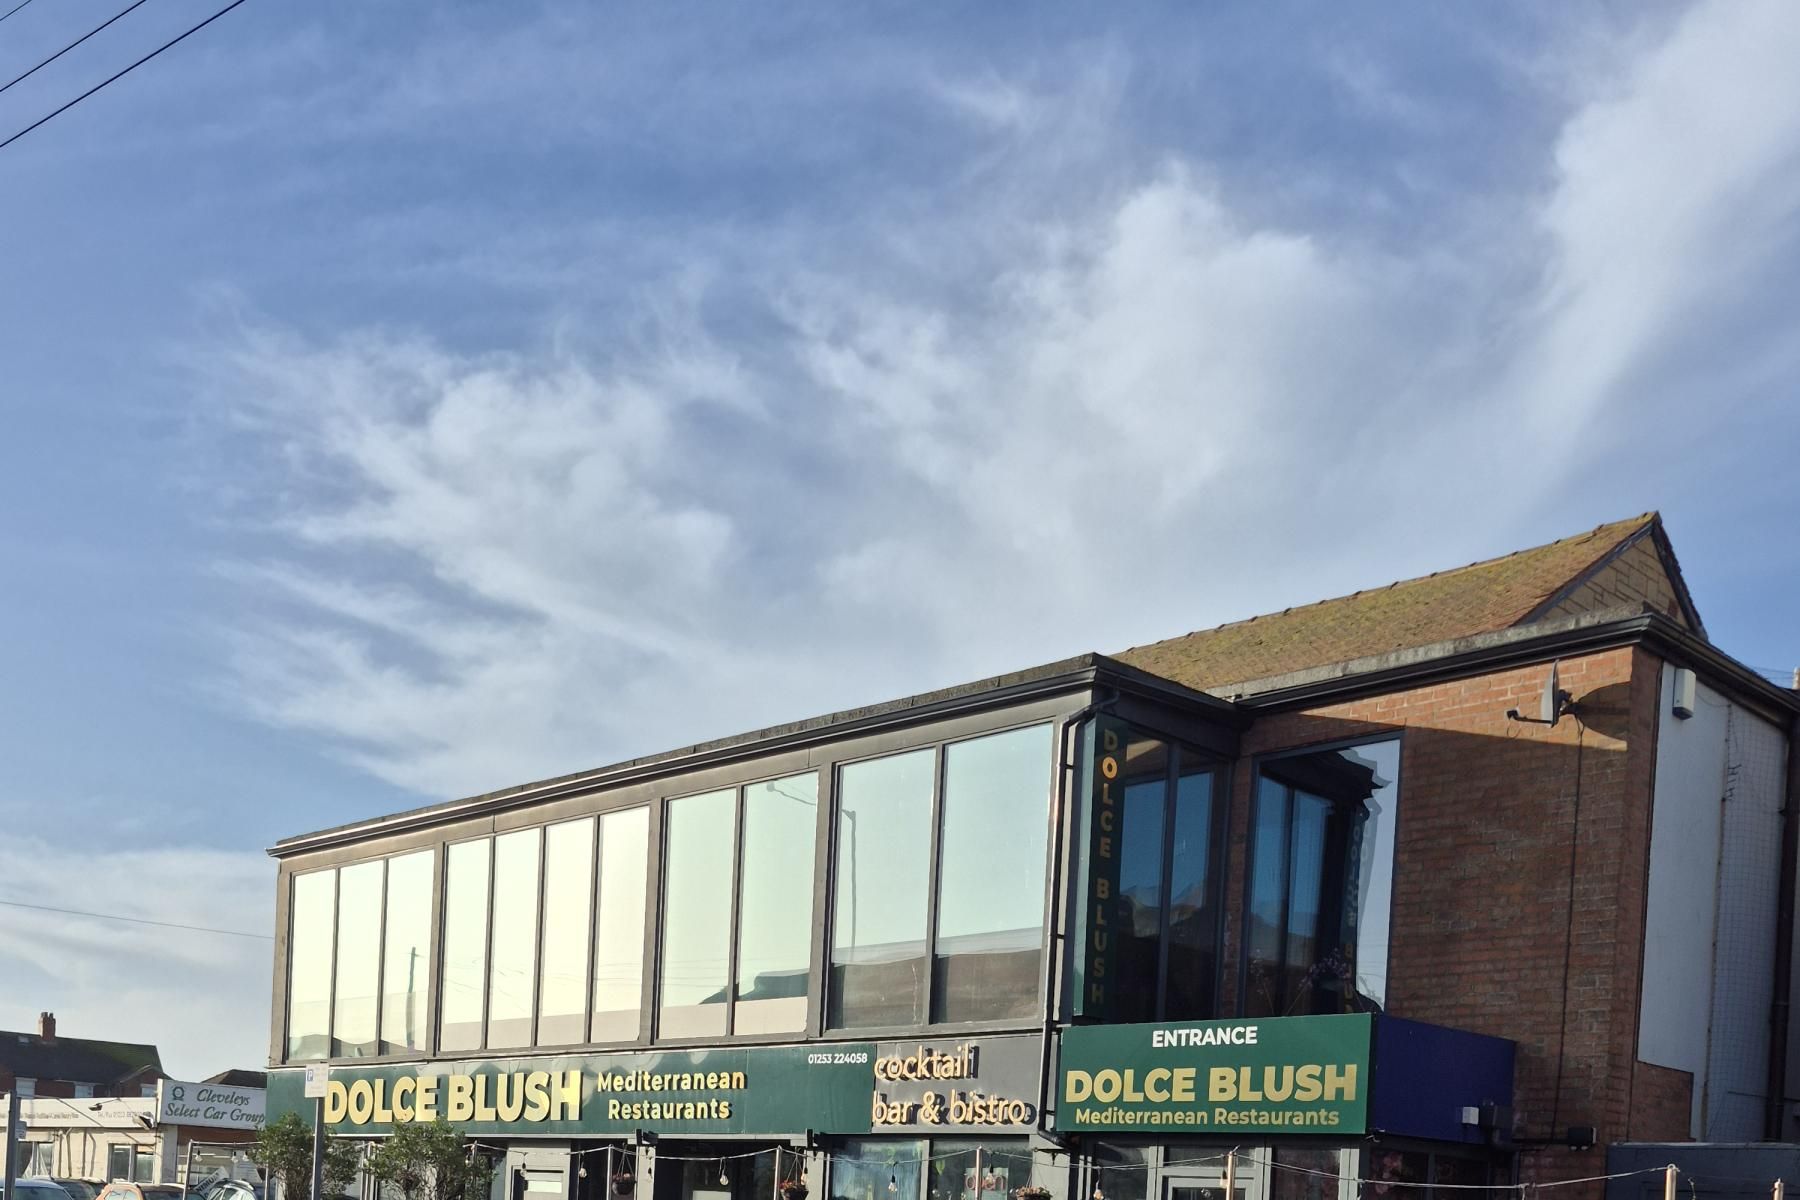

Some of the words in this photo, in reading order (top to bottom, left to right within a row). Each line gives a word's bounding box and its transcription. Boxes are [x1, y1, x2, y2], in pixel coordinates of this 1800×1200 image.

[1099, 728, 1119, 858] DOLCE
[1091, 877, 1110, 1004] BLUSH
[1152, 1026, 1258, 1048] ENTRANCE
[808, 1054, 832, 1064] 01253
[834, 1053, 868, 1064] 224058
[874, 1043, 970, 1080] cocktail
[597, 1071, 746, 1093] Mediterranean
[1065, 1067, 1197, 1103] DOLCE
[1208, 1064, 1358, 1102] BLUSH
[196, 1088, 250, 1106] Cleveleys
[324, 1075, 438, 1125] DOLCE
[447, 1070, 581, 1122] BLUSH
[872, 1090, 912, 1123] bar
[920, 1091, 939, 1123] &
[951, 1089, 1026, 1123] bistro
[165, 1103, 199, 1117] Select
[203, 1106, 227, 1120] Car
[230, 1108, 265, 1125] Group
[608, 1098, 731, 1120] Restaurants
[1075, 1107, 1208, 1125] Mediterranean
[1214, 1107, 1340, 1126] Restaurants
[965, 1175, 1007, 1191] oen
